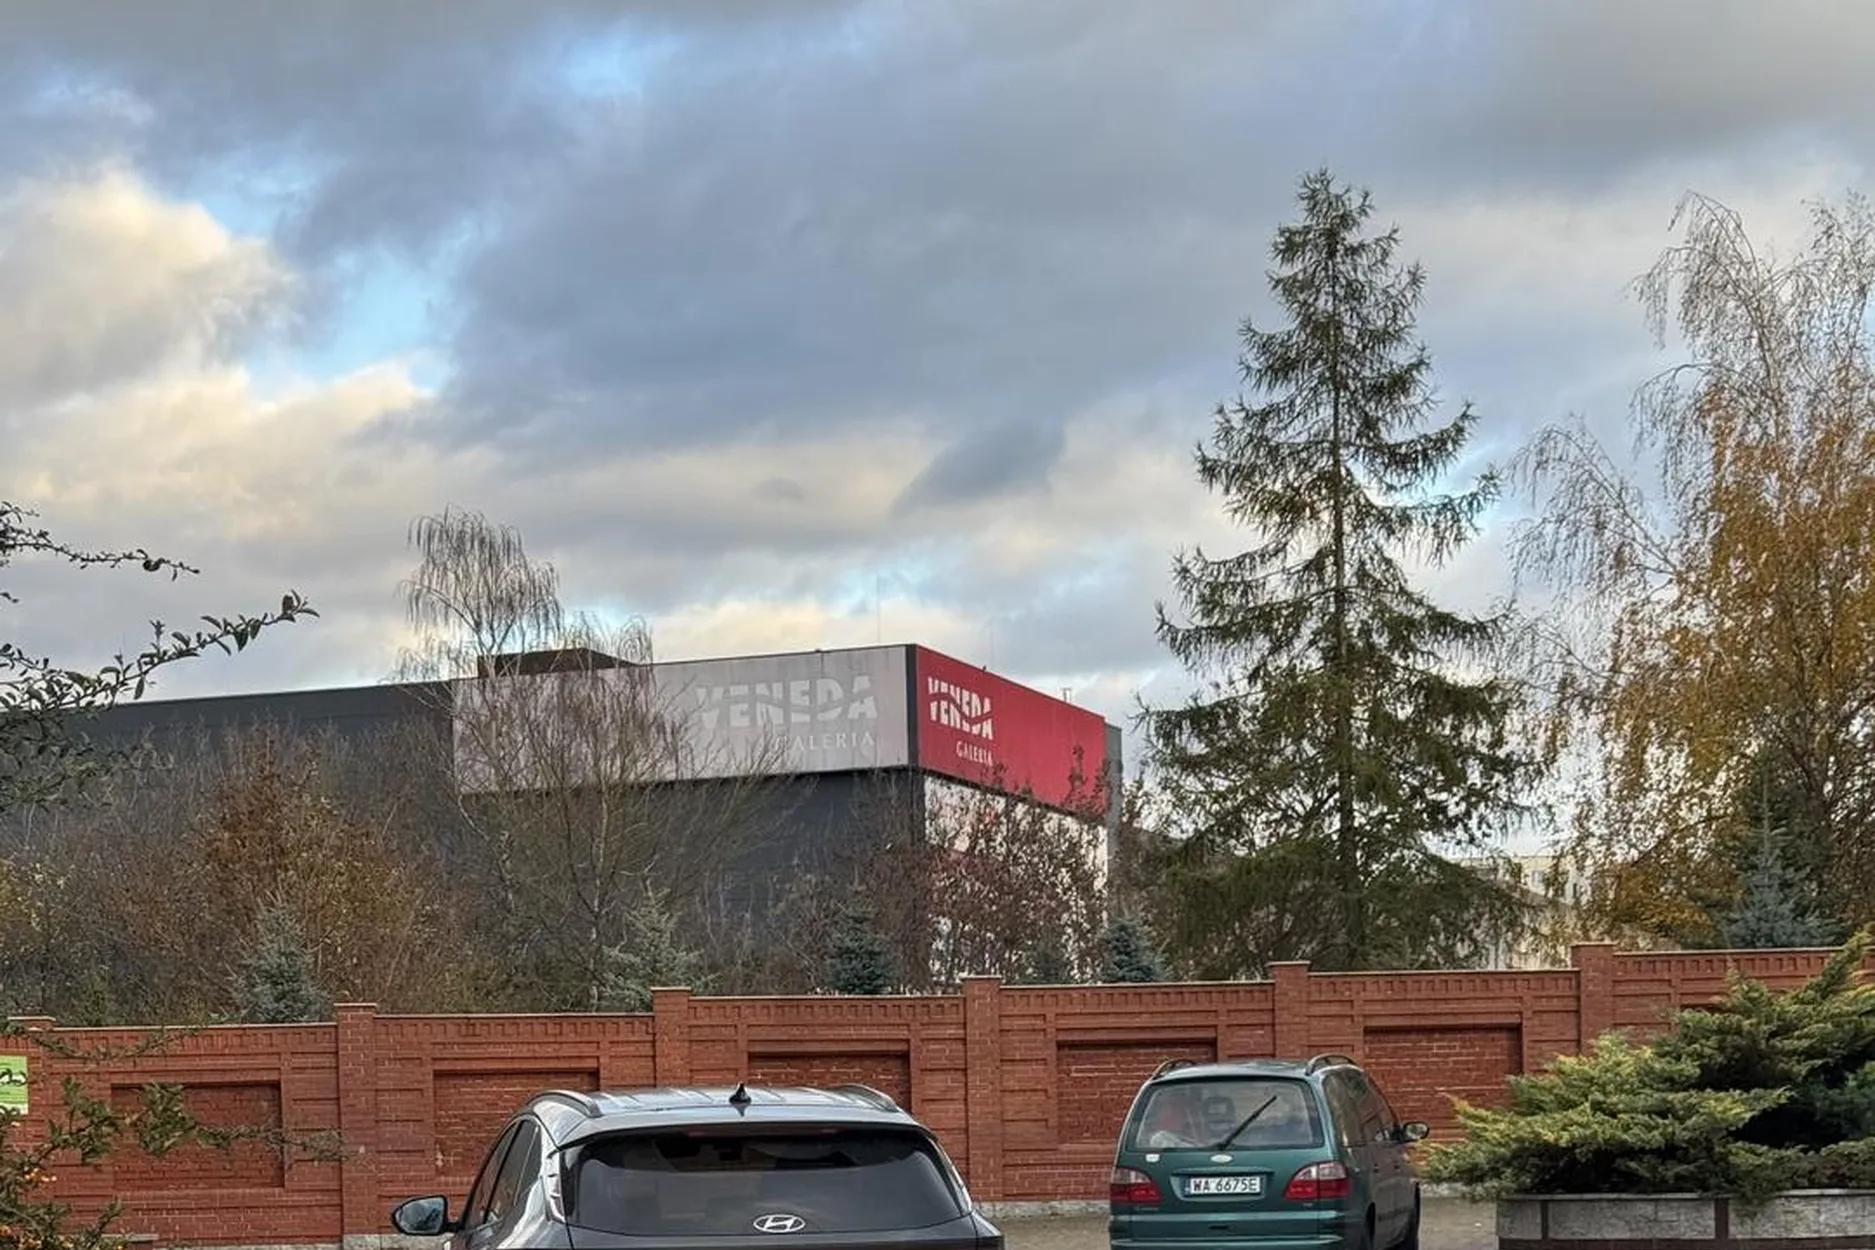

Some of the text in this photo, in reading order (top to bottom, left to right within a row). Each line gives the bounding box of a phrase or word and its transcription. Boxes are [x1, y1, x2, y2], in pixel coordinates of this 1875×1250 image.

[695, 675, 877, 728] VENEDA
[928, 676, 993, 740] VENEDA
[1193, 1178, 1257, 1192] WA 6675E
